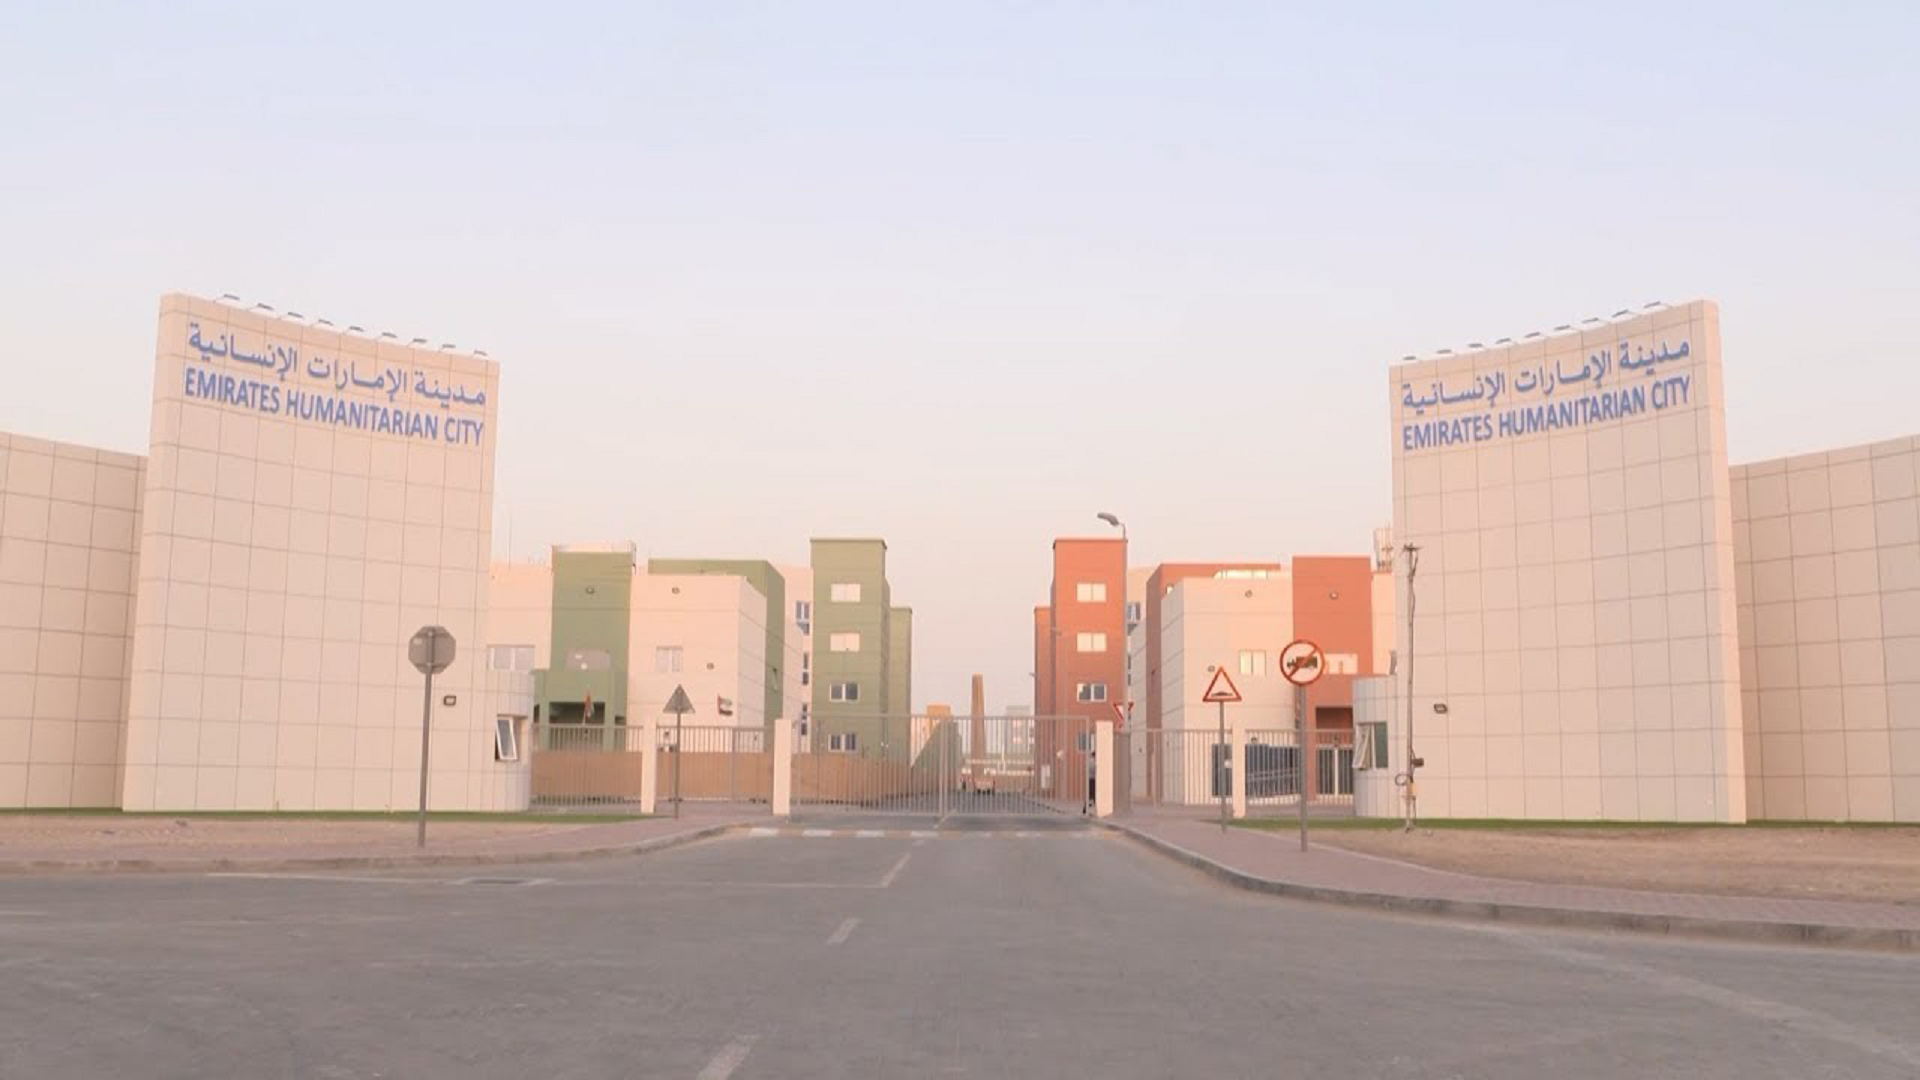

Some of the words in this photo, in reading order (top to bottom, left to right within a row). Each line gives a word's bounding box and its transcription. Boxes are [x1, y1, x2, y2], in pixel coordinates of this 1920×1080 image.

[189, 321, 298, 381] الإنسانية
[1515, 349, 1612, 395] الإمارات
[1619, 337, 1690, 375] مدينة
[307, 356, 408, 402] الإمارات
[414, 368, 486, 409] مدينة
[1402, 371, 1505, 416] الإنسانية
[185, 367, 280, 413] EMIRATES
[286, 390, 439, 441] HUMANITARIAN
[444, 416, 485, 446] CITY
[1403, 412, 1494, 450] EMIRATES
[1499, 384, 1646, 438] HUMANITARIAN
[1652, 375, 1691, 409] CITY
